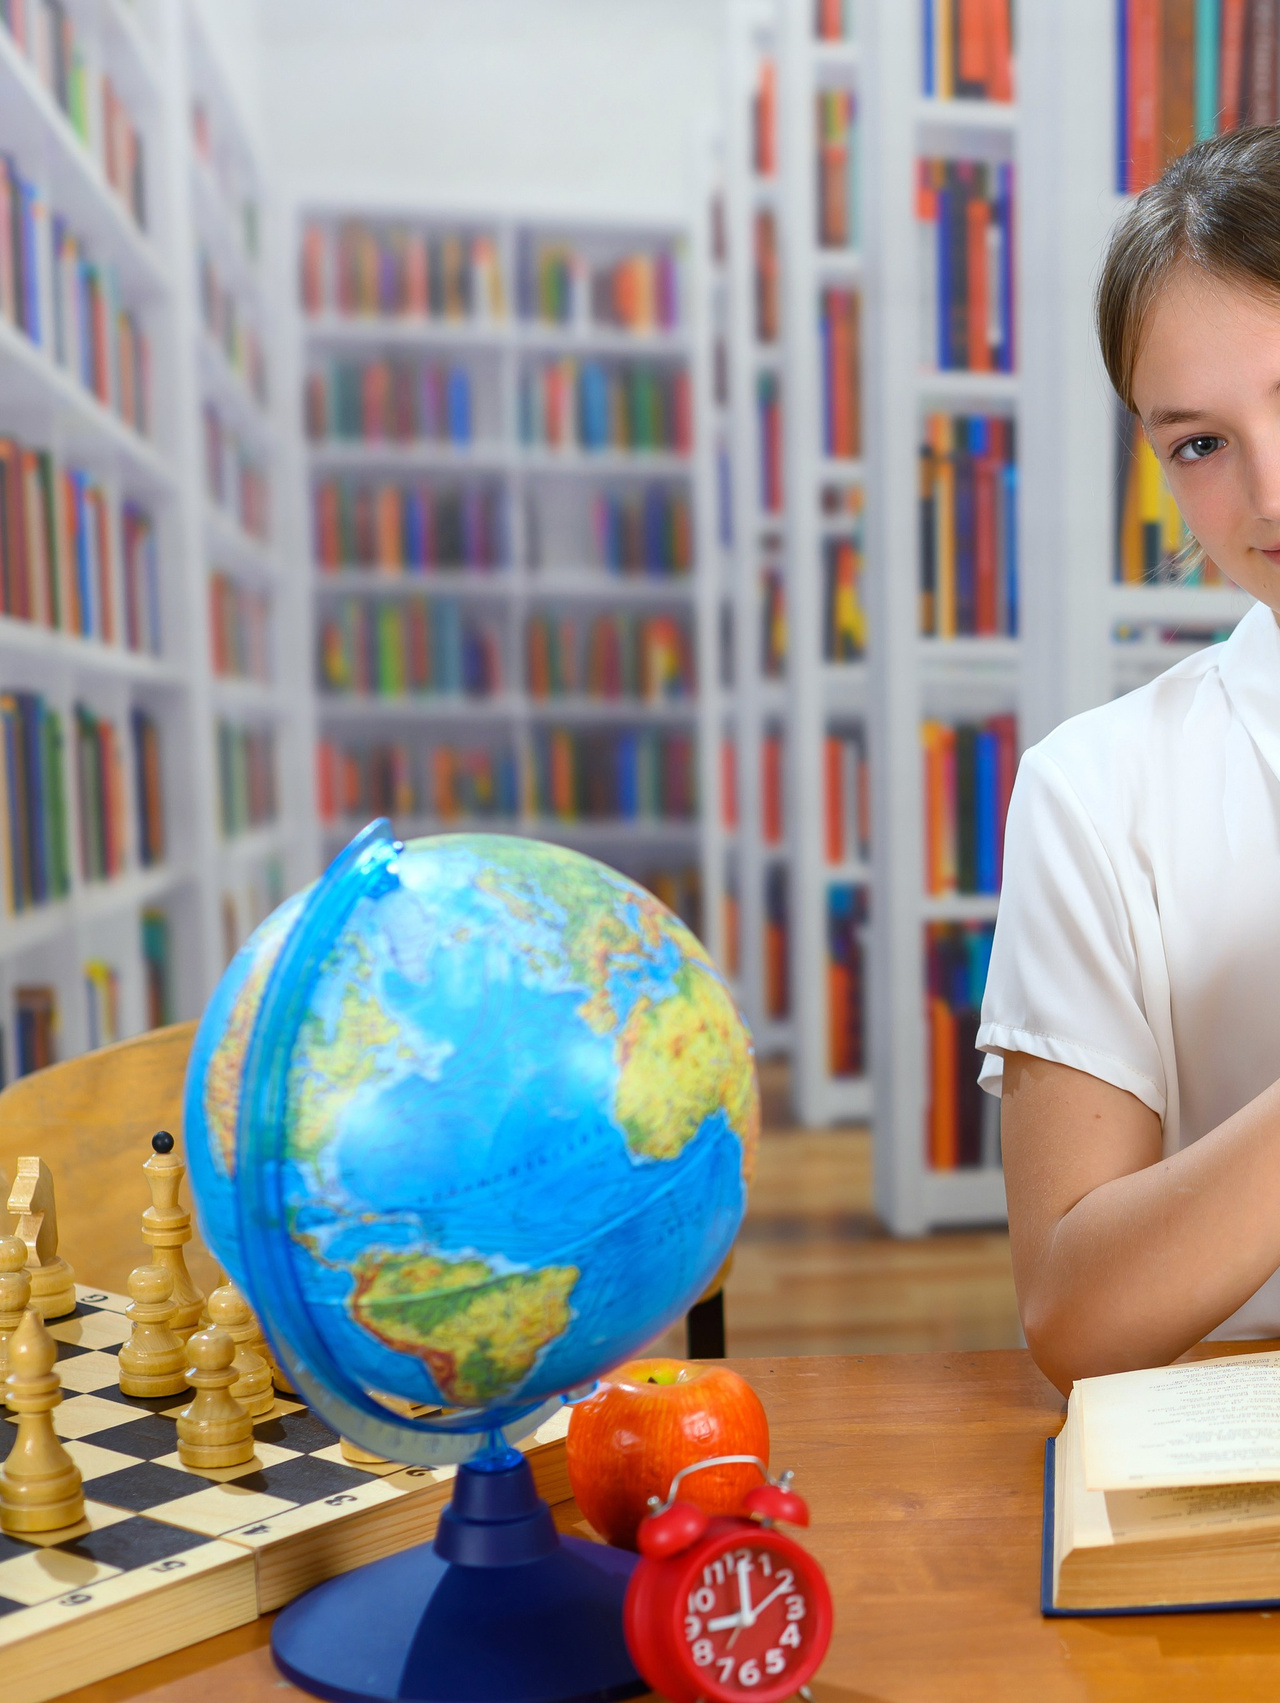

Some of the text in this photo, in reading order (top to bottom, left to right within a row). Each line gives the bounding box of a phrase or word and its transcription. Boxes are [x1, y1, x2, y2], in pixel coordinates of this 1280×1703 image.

[324, 1494, 358, 1506] 3
[241, 1524, 271, 1537] 4
[149, 1560, 187, 1573] 5
[703, 1560, 725, 1587] 11
[758, 1552, 773, 1577] 1
[775, 1568, 796, 1594] 2
[687, 1587, 715, 1613] 10
[785, 1595, 806, 1620] 3
[684, 1614, 702, 1642] 9
[779, 1621, 801, 1649] 4
[692, 1638, 715, 1667] 8
[765, 1647, 786, 1675] 5
[715, 1656, 735, 1684] 7
[738, 1658, 761, 1687] 6
